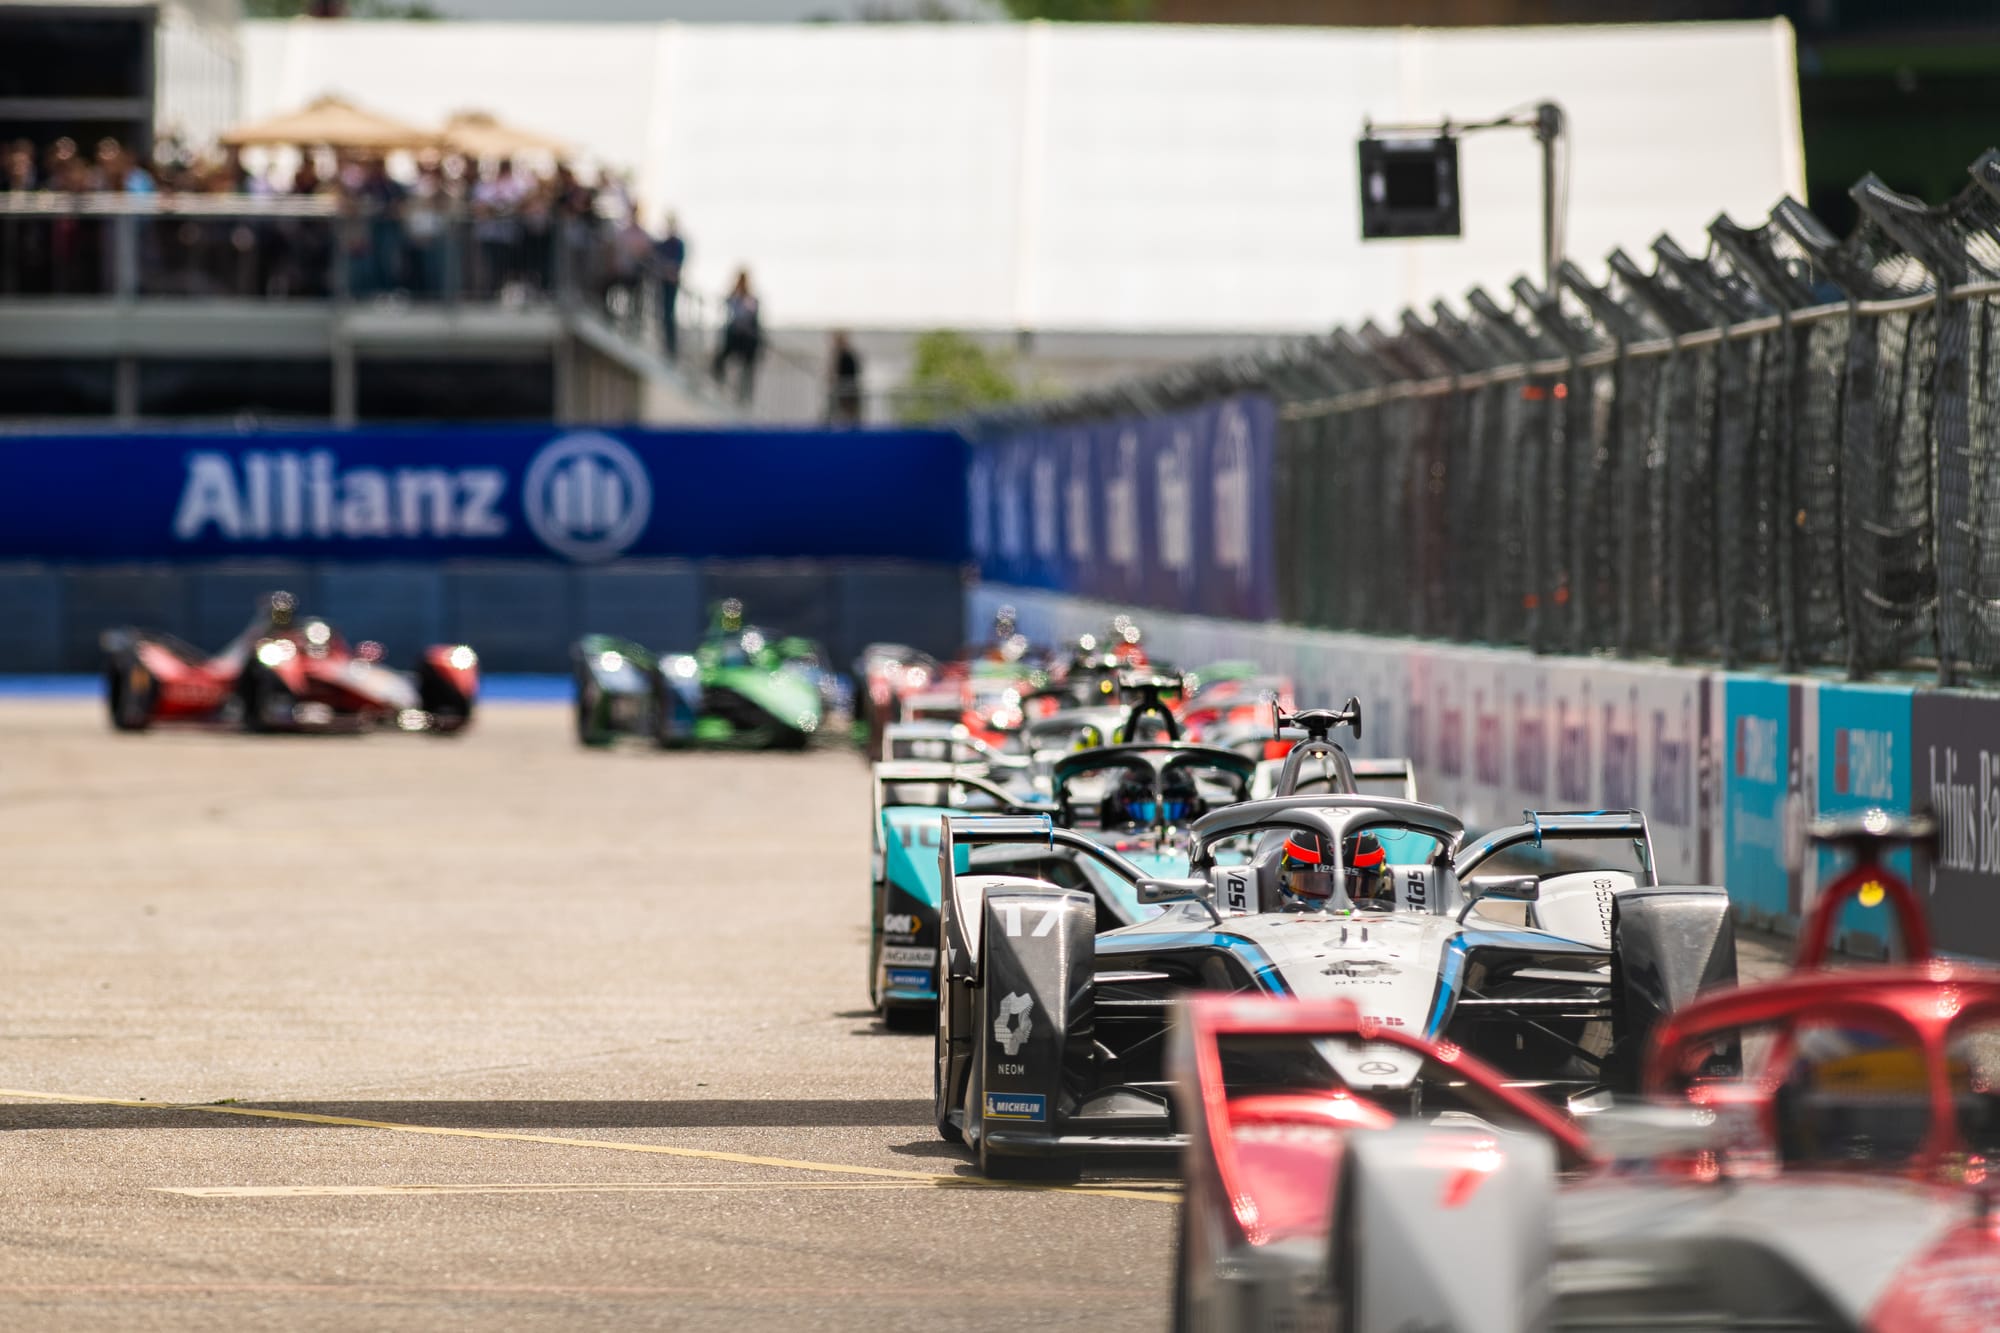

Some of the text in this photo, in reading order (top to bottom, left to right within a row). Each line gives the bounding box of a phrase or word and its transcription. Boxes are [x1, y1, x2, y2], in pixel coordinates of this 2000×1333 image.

[174, 450, 506, 539] Allianz
[1313, 864, 1360, 876] Vesas
[994, 902, 1062, 937] 17
[998, 1064, 1024, 1075] NEOM
[997, 1102, 1040, 1113] MICHELIN
